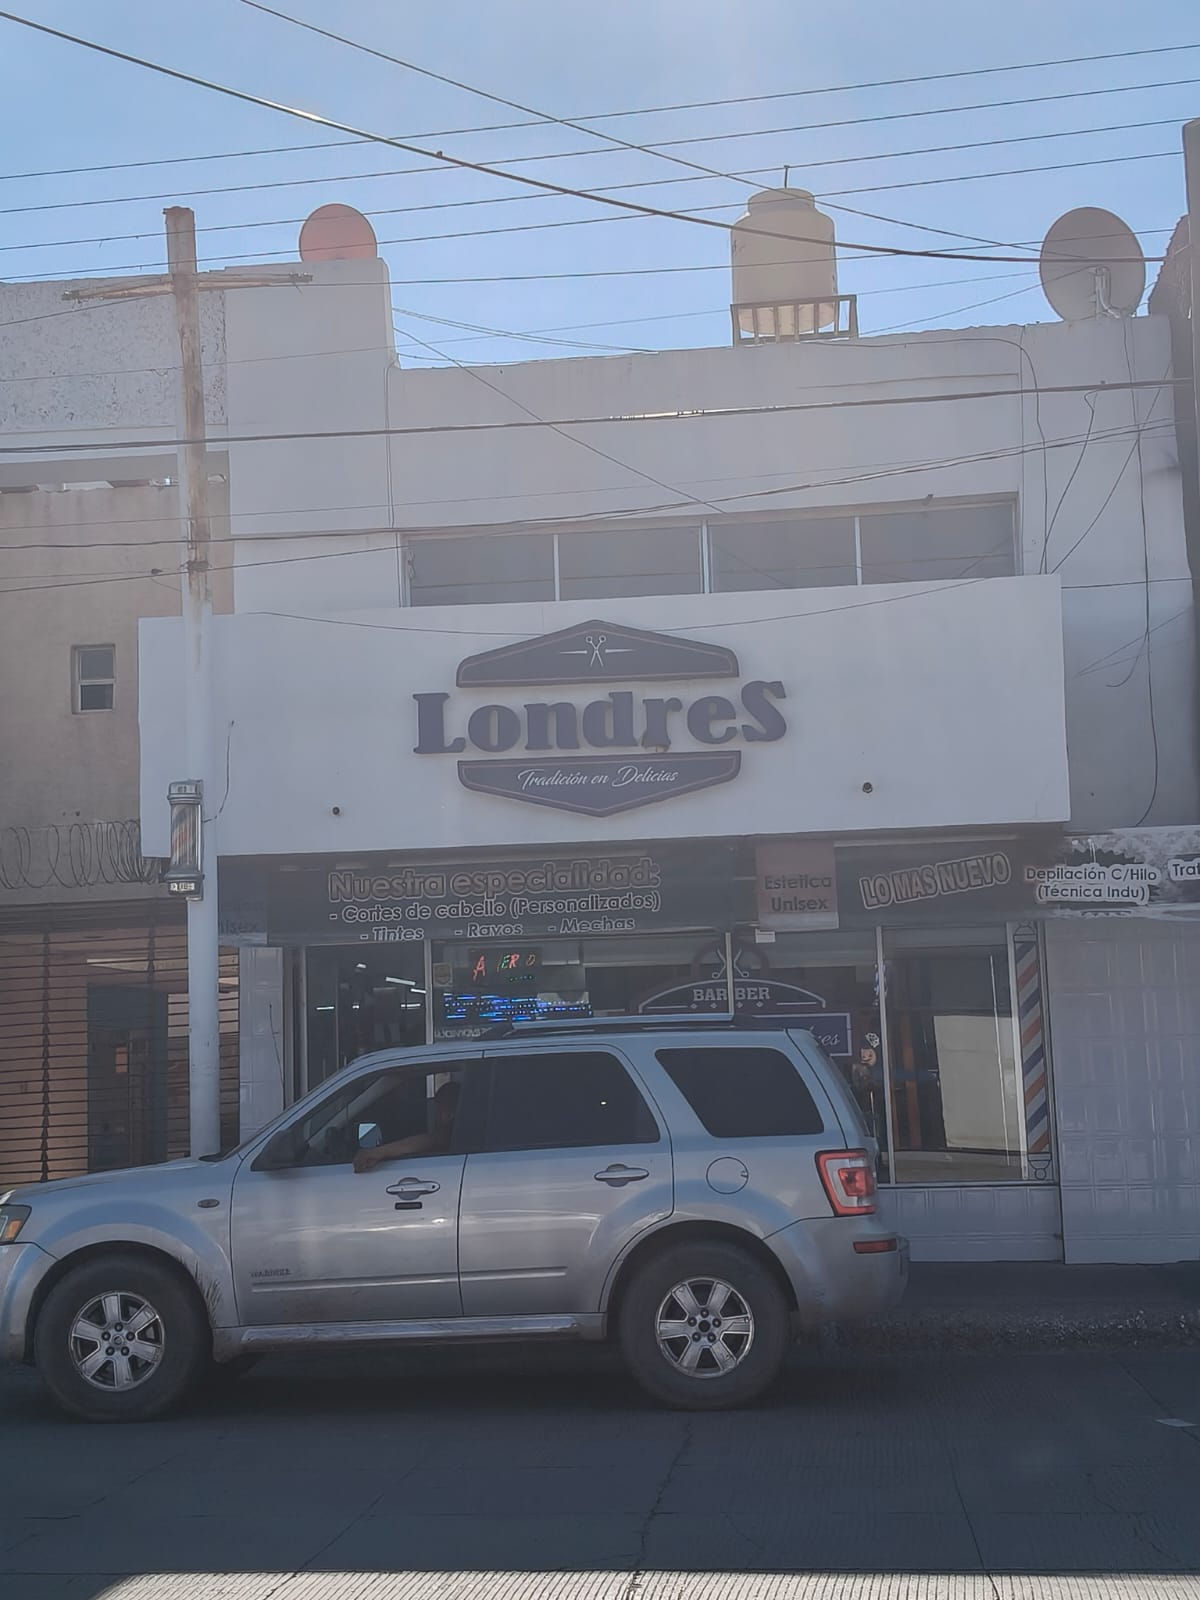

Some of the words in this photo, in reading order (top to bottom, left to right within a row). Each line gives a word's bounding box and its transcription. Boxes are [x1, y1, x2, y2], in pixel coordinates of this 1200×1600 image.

[518, 768, 588, 790] Tradición
[590, 774, 609, 786] en
[612, 765, 678, 788] Delicias
[329, 869, 446, 902] Nuestra
[450, 857, 661, 899] especialidad:
[858, 876, 893, 910] LO
[894, 868, 936, 902] MAS
[938, 853, 1011, 894] NUEVO
[1026, 866, 1106, 883] Depilación
[1111, 867, 1158, 882] C/Hilo
[770, 895, 829, 912] Unisex
[1038, 884, 1102, 900] (Técnica
[1107, 886, 1146, 901] Indu)
[342, 904, 402, 923] Cortes
[405, 902, 432, 919] de
[435, 900, 506, 919] cabello
[510, 890, 661, 918] (Personalizados)
[372, 925, 424, 941] Tintes
[560, 916, 636, 934] Mechas
[693, 987, 770, 1002] BARBER
